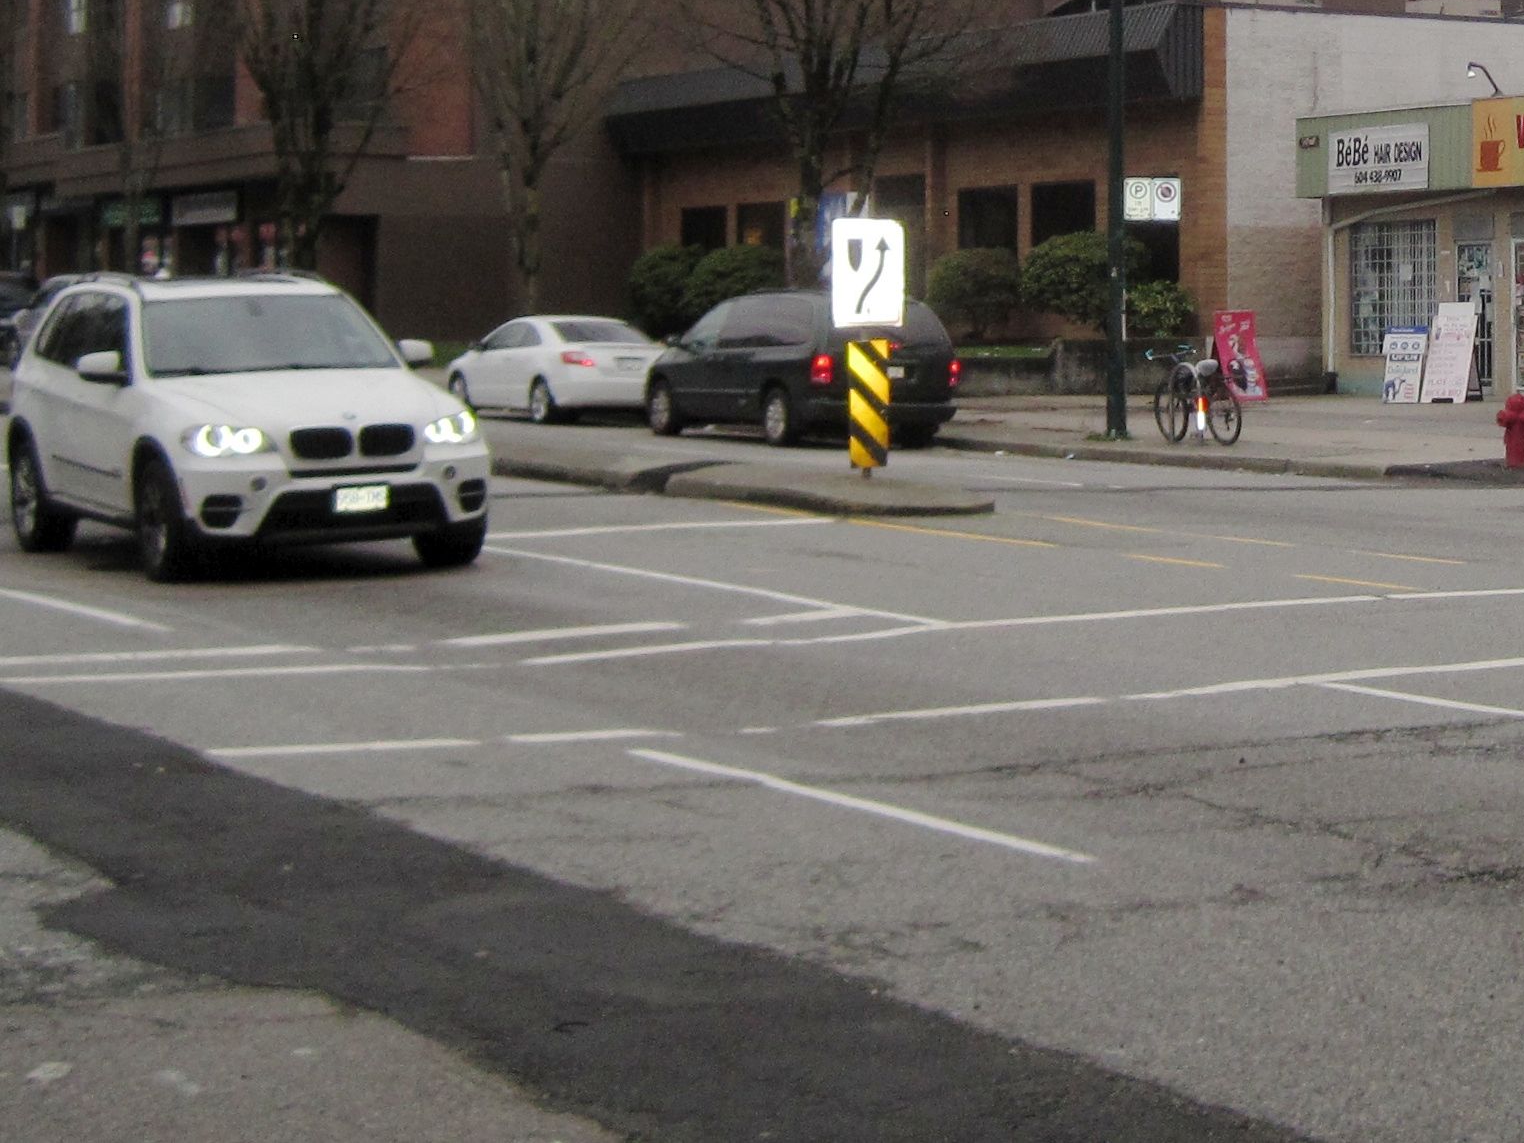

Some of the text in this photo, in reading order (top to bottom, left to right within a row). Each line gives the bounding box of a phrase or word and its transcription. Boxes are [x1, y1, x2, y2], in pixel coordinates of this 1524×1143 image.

[1336, 135, 1369, 167] BéBé
[1373, 143, 1391, 164] HAIR
[1394, 141, 1422, 163] DESIGN
